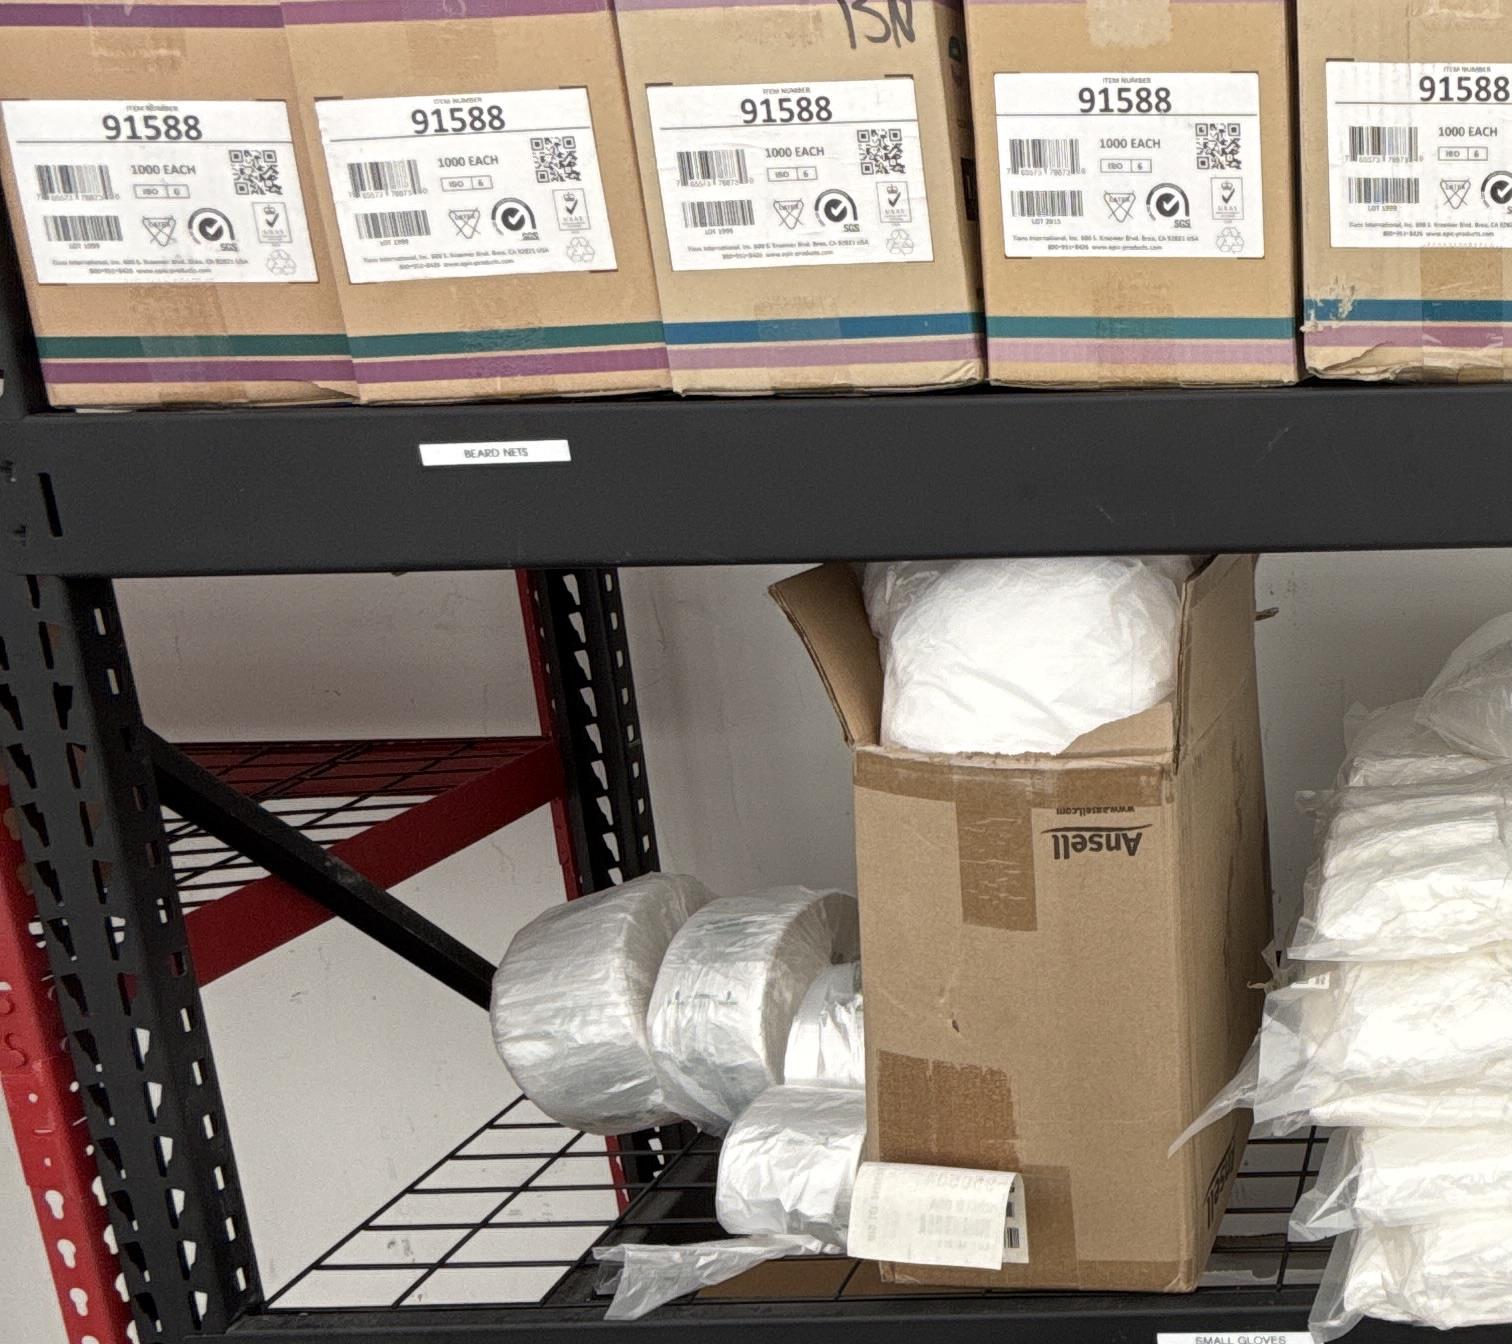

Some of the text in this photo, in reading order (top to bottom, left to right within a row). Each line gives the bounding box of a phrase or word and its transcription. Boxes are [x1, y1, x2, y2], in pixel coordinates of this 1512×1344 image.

[1419, 76, 1510, 101] 91588
[1079, 87, 1172, 113] 91588
[741, 96, 832, 123] 91588
[411, 105, 505, 134] 91588
[103, 115, 202, 140] 91588
[1439, 127, 1497, 137] 1000 EACH
[1100, 139, 1160, 149] 1000 EACH
[765, 147, 824, 157] 1000 EACH
[439, 155, 498, 167] 1000 EACH
[131, 165, 195, 175] 1000 EACH
[464, 448, 529, 459] BEARD NETS
[1052, 832, 1143, 860] Ansell
[1238, 1336, 1286, 1344] GLOVES
